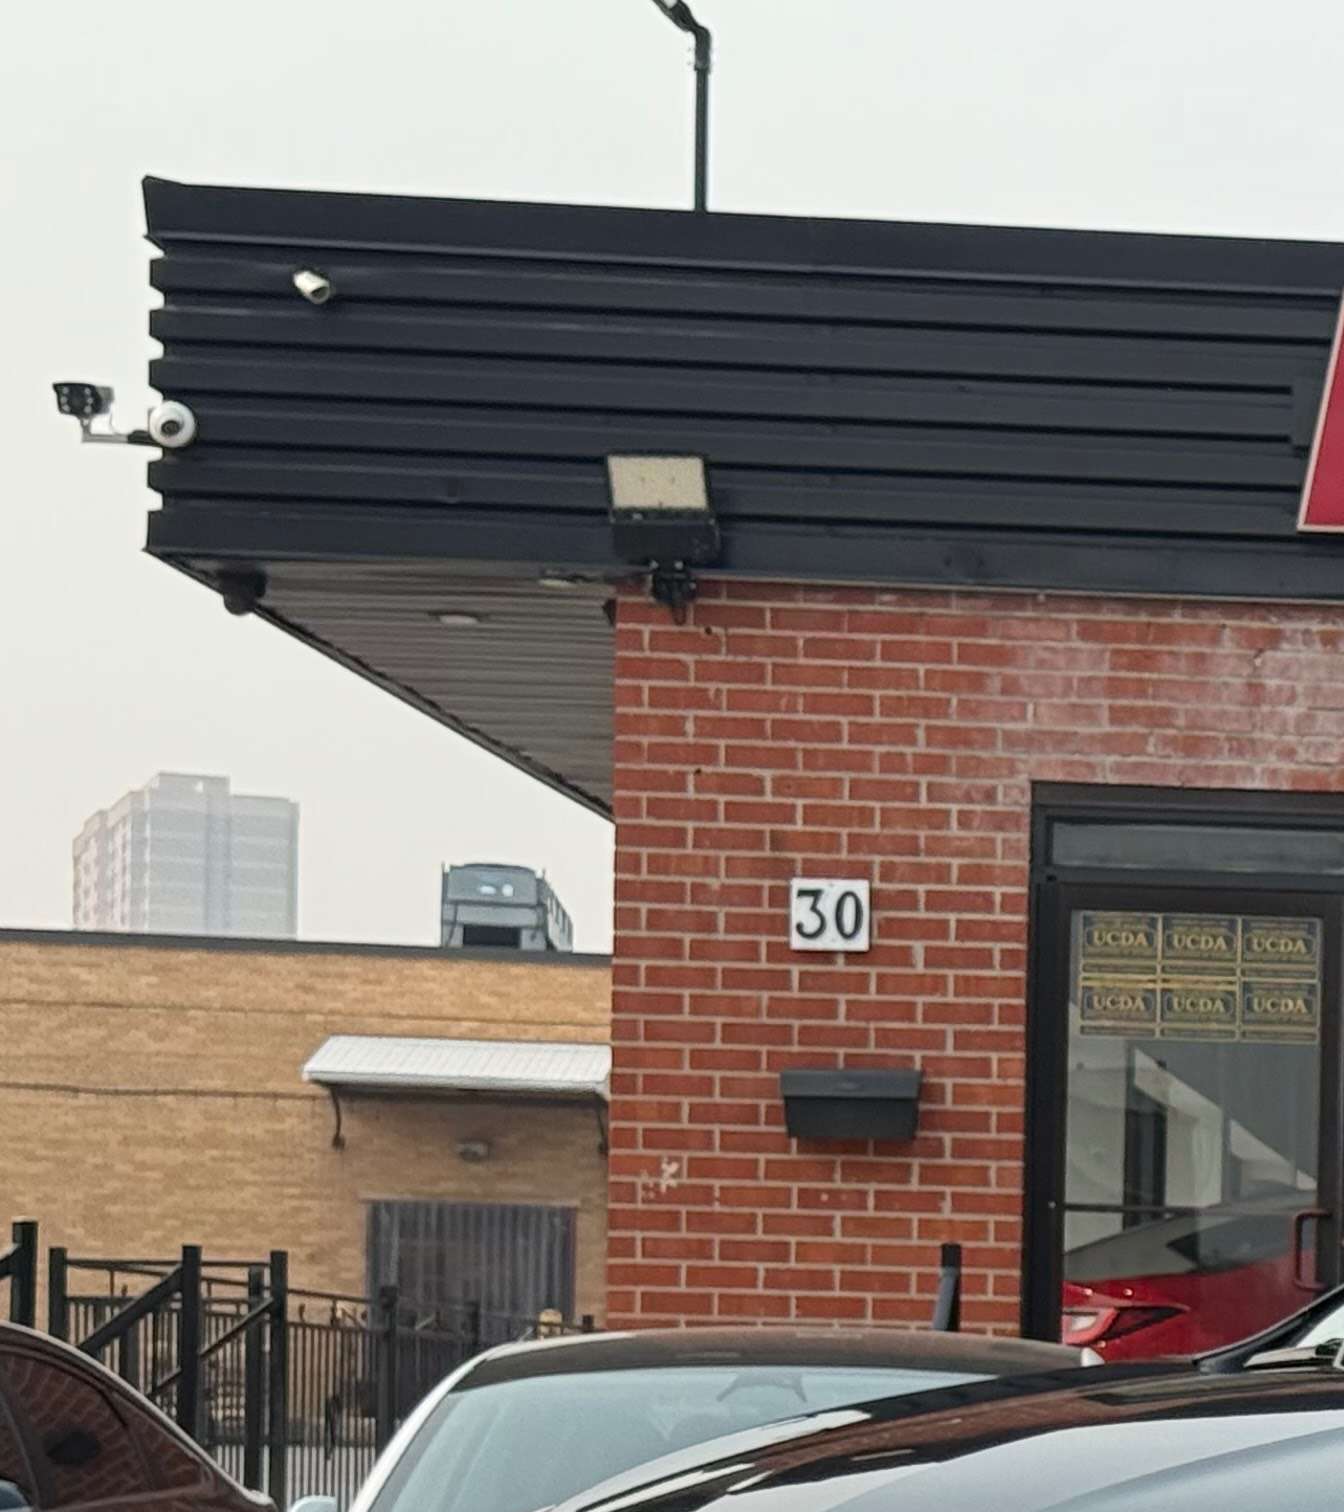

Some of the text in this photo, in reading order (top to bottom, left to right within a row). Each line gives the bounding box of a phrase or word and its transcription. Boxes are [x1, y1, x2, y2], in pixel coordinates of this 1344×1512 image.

[795, 888, 864, 940] 30
[1093, 931, 1148, 946] UCDA
[1173, 934, 1227, 951] UCDA
[1252, 937, 1307, 953] UCDA
[1093, 995, 1146, 1011] UCDA
[1173, 996, 1226, 1012] UCDA
[1253, 997, 1308, 1013] UCDA
